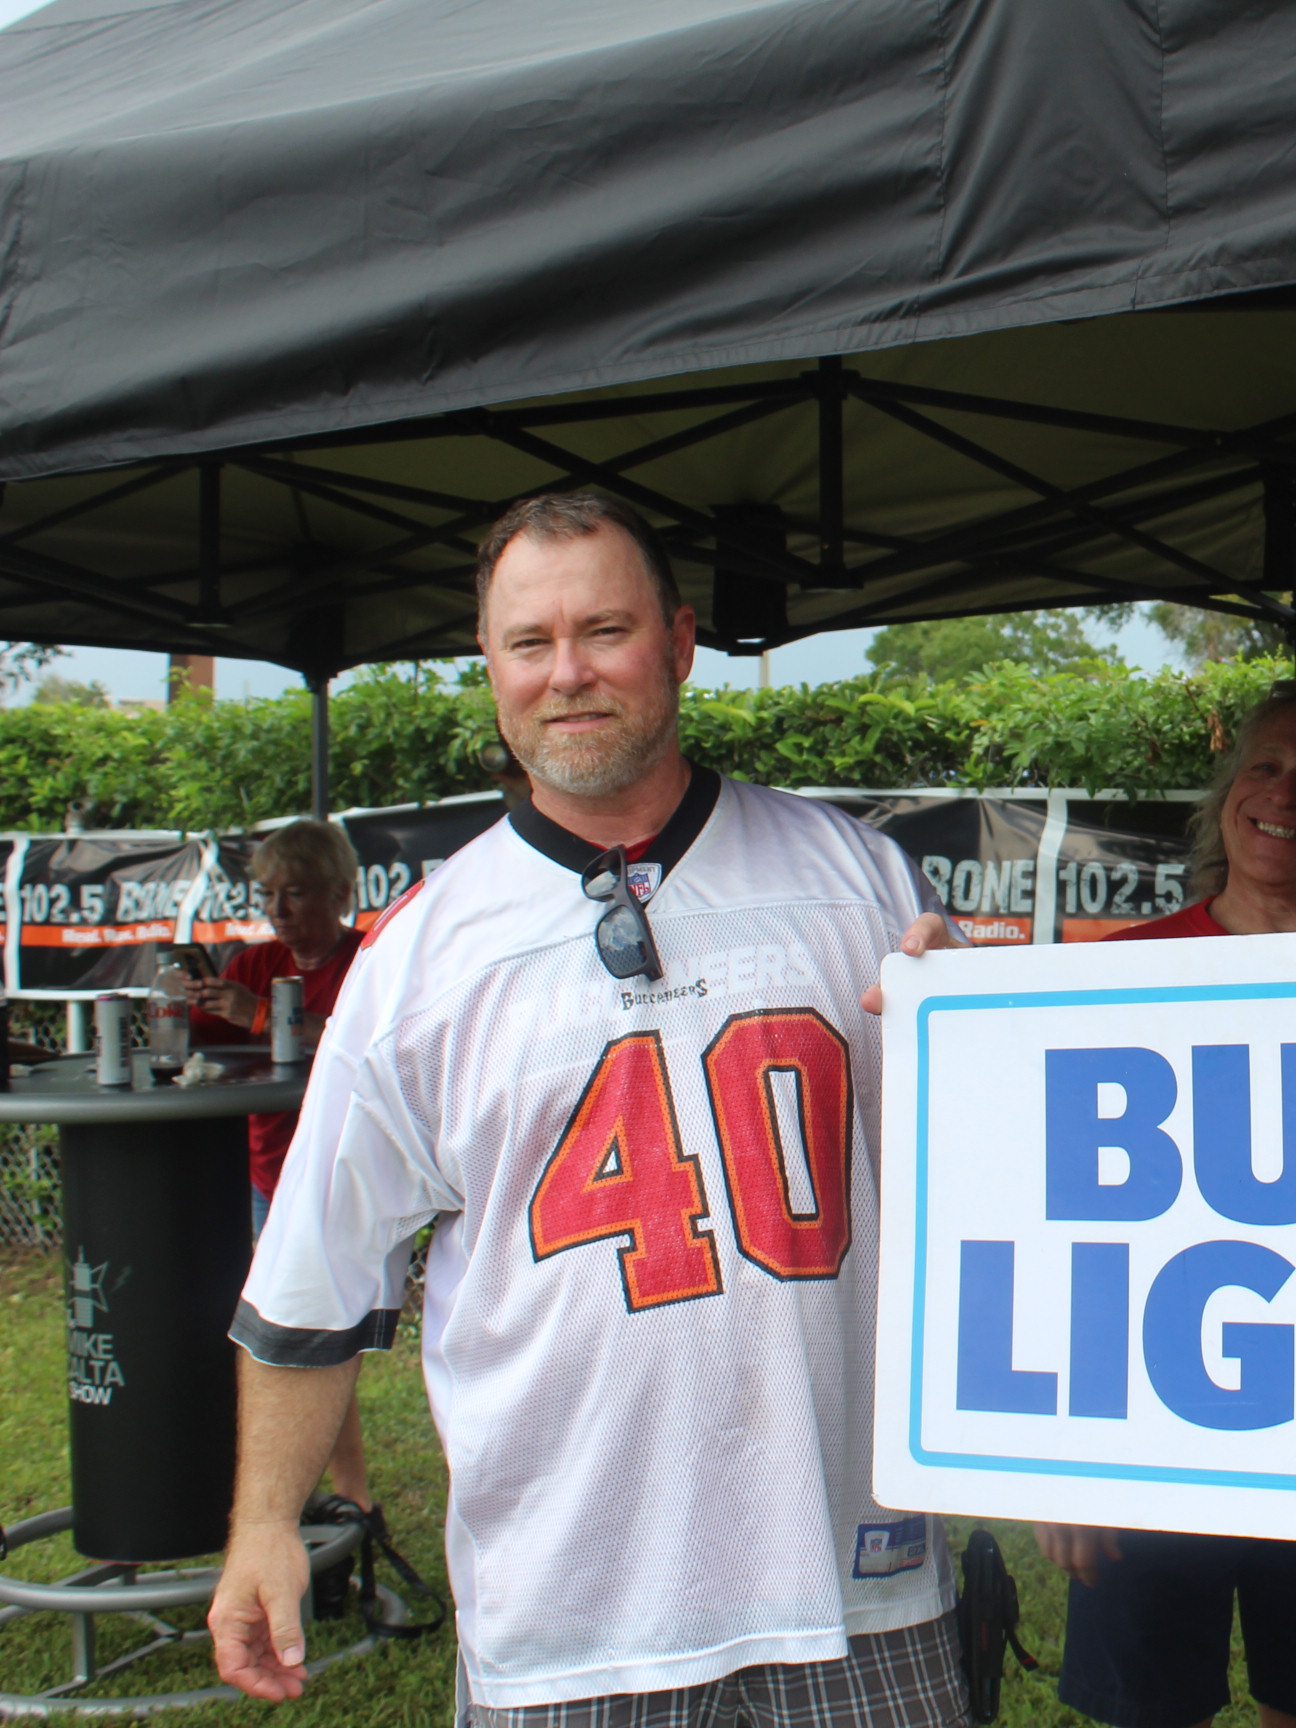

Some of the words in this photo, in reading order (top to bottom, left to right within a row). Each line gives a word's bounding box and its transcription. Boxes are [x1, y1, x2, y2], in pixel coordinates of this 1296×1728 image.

[21, 884, 105, 924] 102.5
[922, 855, 1034, 913] BONE
[1059, 861, 1186, 915] 102.5
[958, 920, 1025, 939] Radio.
[529, 1007, 854, 1314] 40
[69, 1331, 114, 1359] MIKE
[68, 1356, 125, 1386] ALTA
